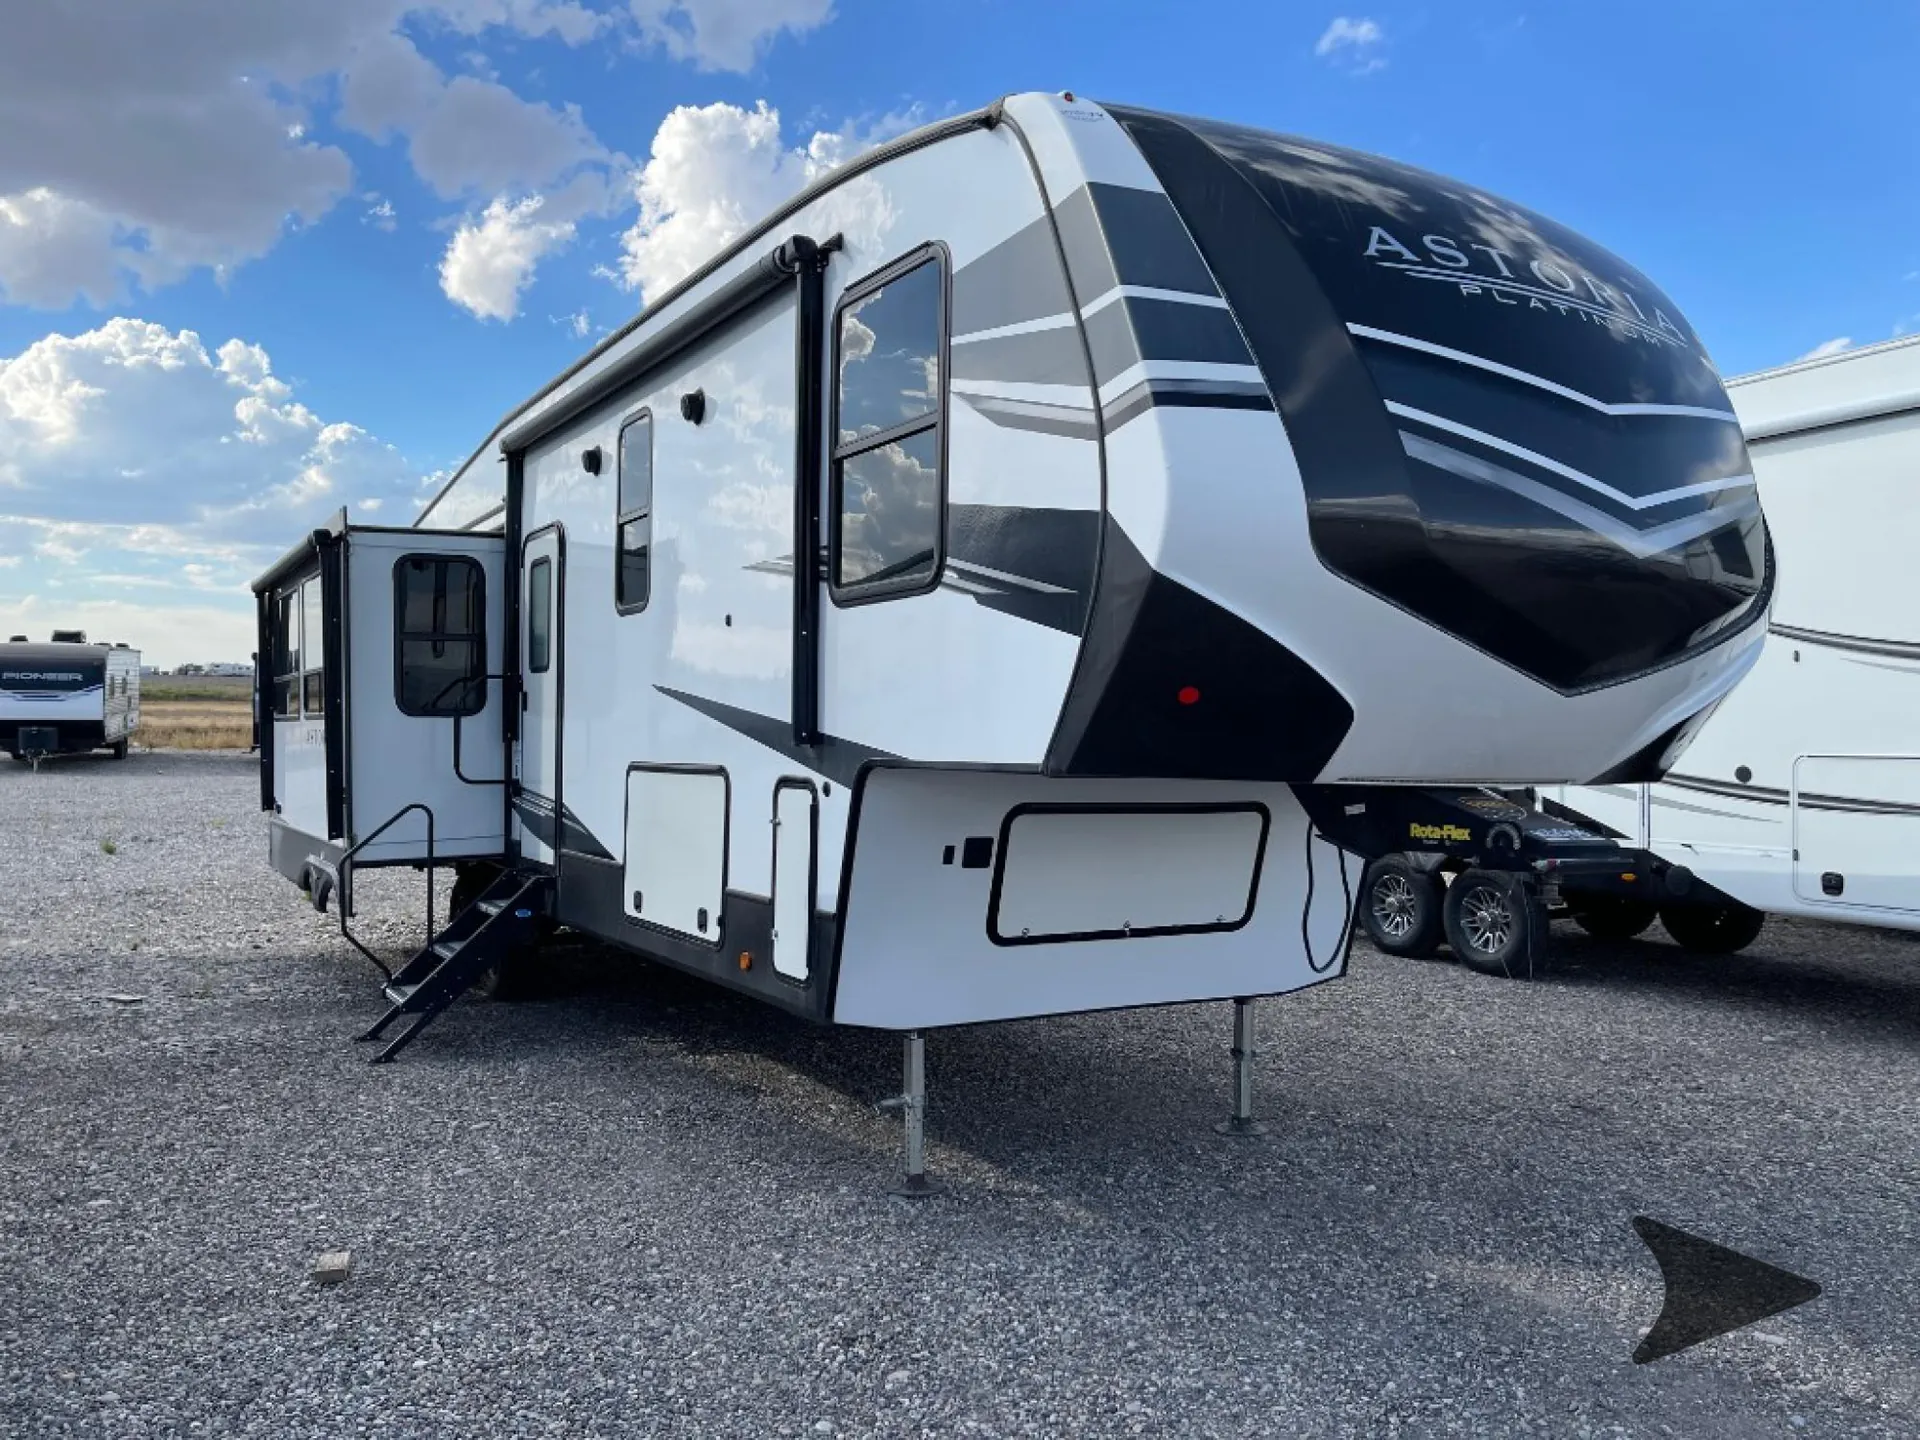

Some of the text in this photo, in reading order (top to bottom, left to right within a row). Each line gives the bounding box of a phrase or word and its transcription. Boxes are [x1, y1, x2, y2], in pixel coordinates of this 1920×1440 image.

[1363, 226, 1686, 342] ASTORIA
[1459, 283, 1661, 348] PLATINUM
[2, 672, 83, 681] PIONEER
[1409, 823, 1471, 841] Rota-Flex
